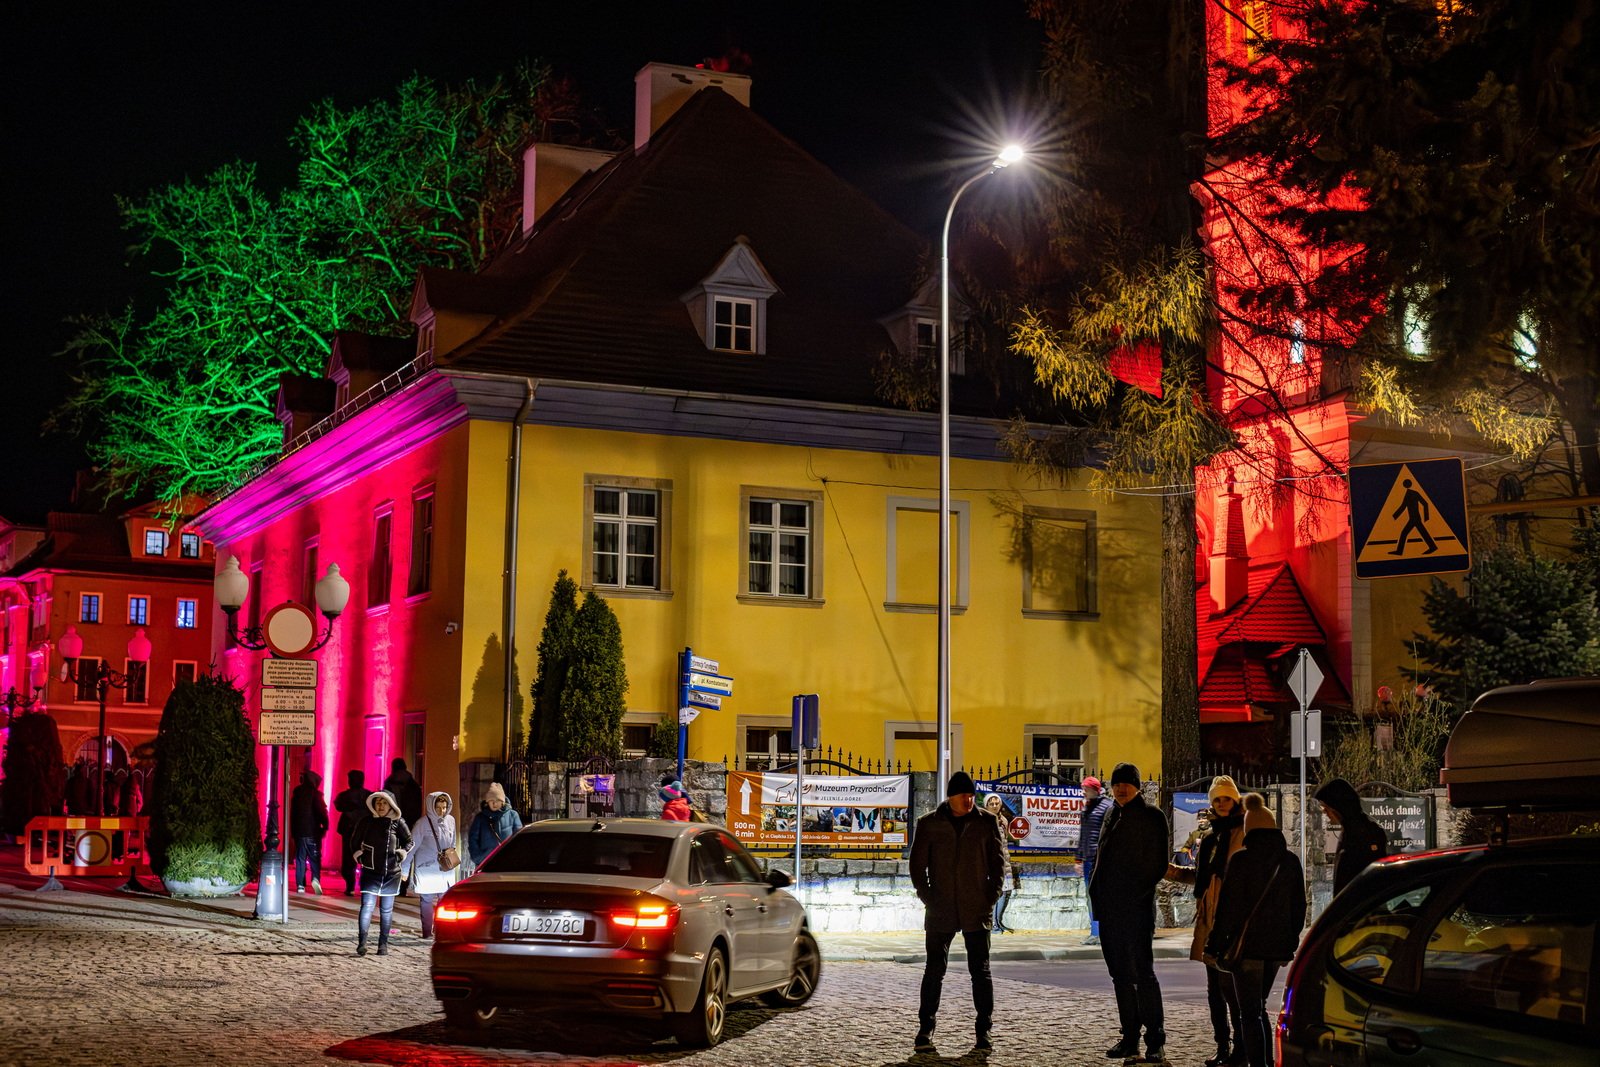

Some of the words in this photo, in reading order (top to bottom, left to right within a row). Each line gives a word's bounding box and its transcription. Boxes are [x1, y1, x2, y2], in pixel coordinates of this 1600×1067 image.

[815, 785, 848, 793] Muzeum
[850, 785, 897, 794] Przyrodnicze
[976, 783, 993, 791] NIE
[995, 785, 1037, 794] ZRYWAJ
[1048, 788, 1085, 797] KULTUR
[1369, 805, 1394, 816] Jakie
[1396, 805, 1421, 816] danie
[1377, 820, 1395, 832] siaj
[1397, 819, 1425, 832] zjesz?
[741, 830, 755, 838] min
[512, 917, 530, 932] DJ
[535, 918, 581, 934] 3978C
